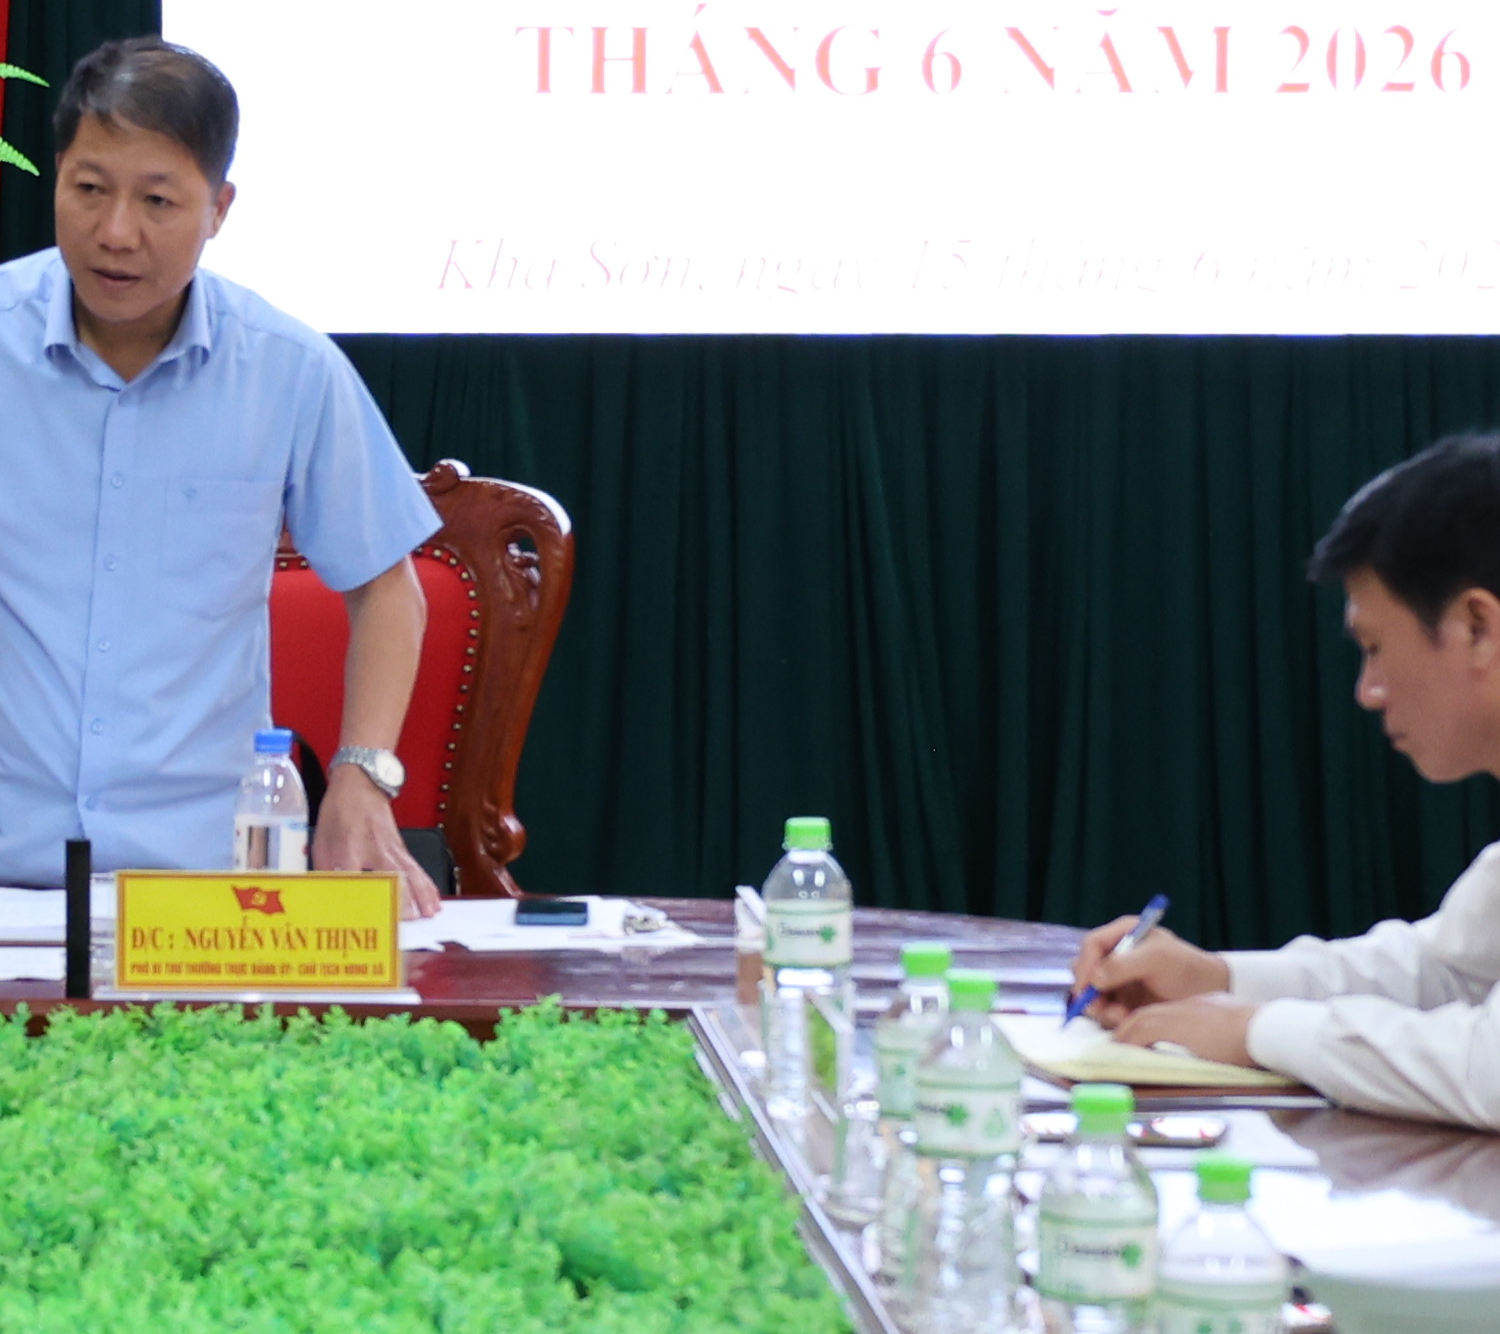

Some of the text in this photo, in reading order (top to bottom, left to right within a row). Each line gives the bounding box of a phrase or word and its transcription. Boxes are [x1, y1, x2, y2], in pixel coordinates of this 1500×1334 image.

[513, 1, 1473, 96] THÁNG 6 NĂM 2026
[185, 915, 265, 951] NGUYỄN
[271, 921, 309, 951] VĂN
[315, 926, 379, 959] THỊNH
